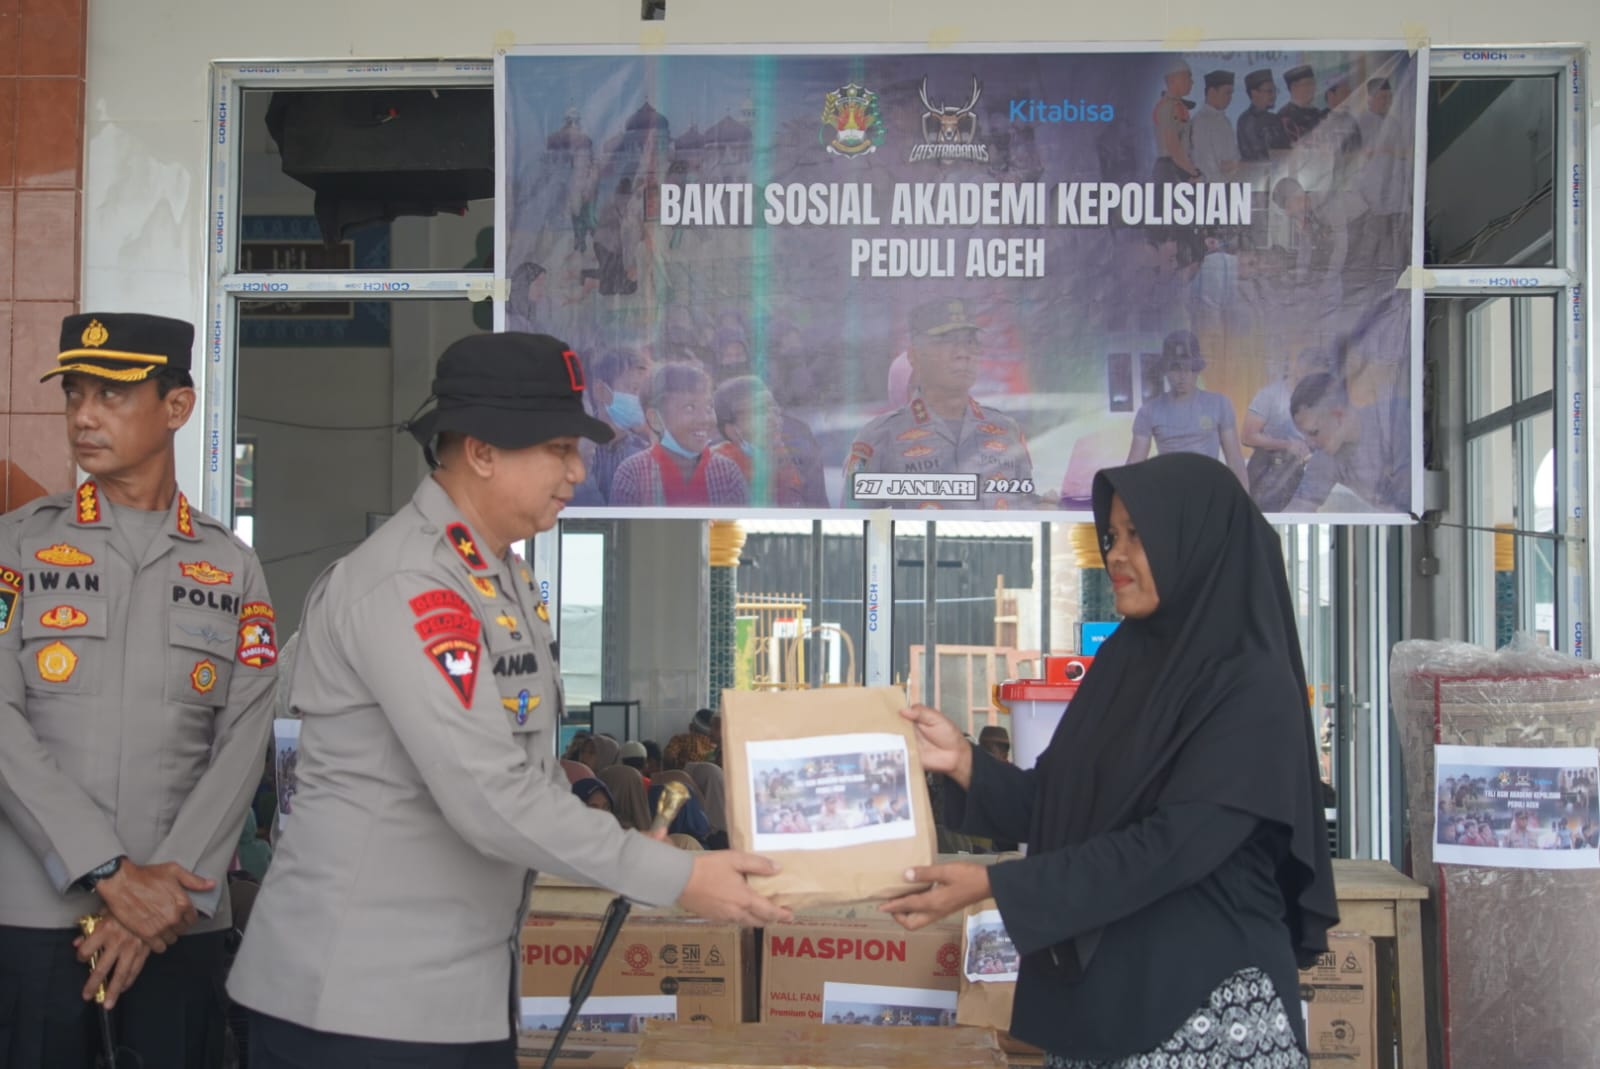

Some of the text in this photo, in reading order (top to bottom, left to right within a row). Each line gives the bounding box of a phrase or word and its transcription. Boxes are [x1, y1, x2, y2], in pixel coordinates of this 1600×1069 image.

[1463, 52, 1507, 61] CONCH
[218, 102, 226, 144] CONCH
[1009, 100, 1114, 123] Kitabisa
[660, 181, 1252, 226] BAKTI SOSIAL AKADEMI KEPOLISIAN
[216, 211, 224, 253] CONCH
[851, 237, 1046, 277] PEDULI ACEH
[243, 282, 288, 291] CONCH
[363, 282, 410, 291] CONCH
[1489, 277, 1539, 286] CONCH
[214, 320, 222, 363] CONCH
[211, 430, 219, 472] CONCH
[855, 478, 1034, 495] 27 JANUARI 2026
[28, 571, 99, 593] IWAN
[172, 585, 240, 617] POLRI
[869, 583, 878, 632] CONCH
[682, 946, 700, 960] SNI
[771, 936, 906, 962] MASPION
[770, 991, 820, 1002] WALL FAN
